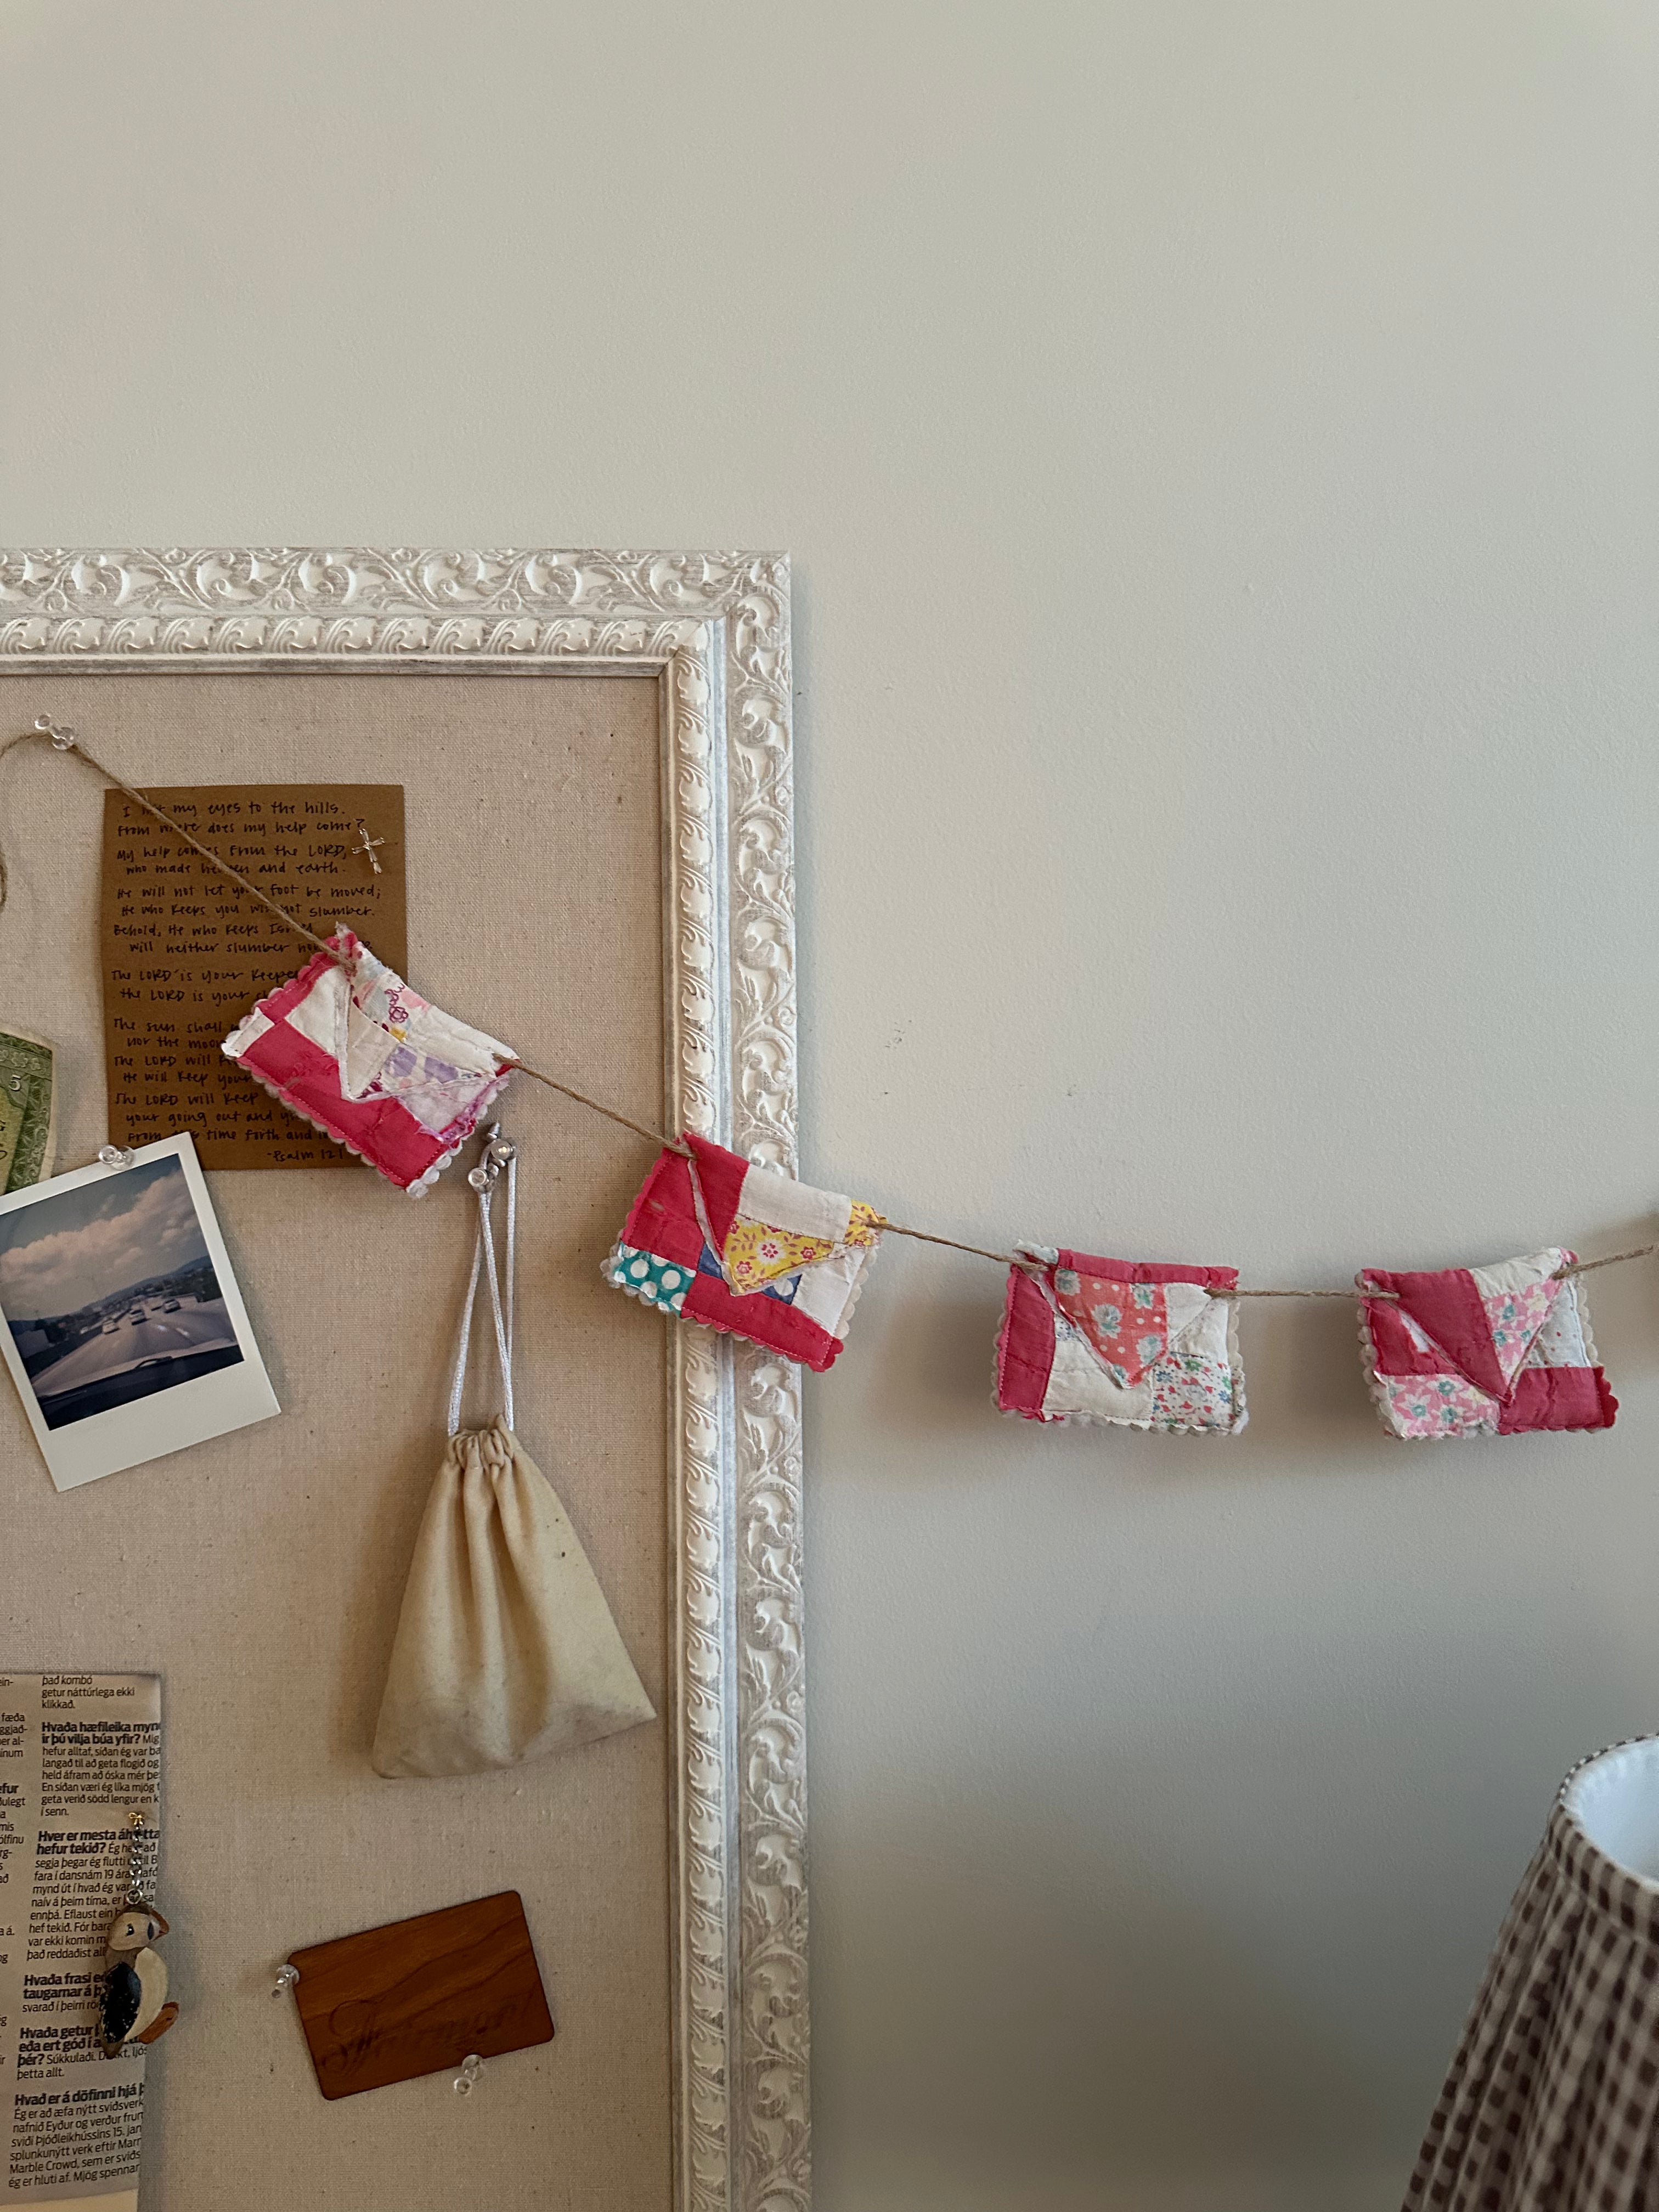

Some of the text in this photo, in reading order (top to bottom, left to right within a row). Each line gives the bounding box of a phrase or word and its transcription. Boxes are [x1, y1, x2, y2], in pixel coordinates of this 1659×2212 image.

[173, 804, 197, 817] my
[208, 803, 240, 816] eyes
[271, 802, 295, 814] the
[305, 802, 345, 814] hills.
[208, 819, 365, 837] does my help come?
[117, 844, 346, 862] My help the LORD,
[127, 862, 346, 875] who made and earth.
[117, 884, 380, 899] He will not let foot be moved;
[142, 904, 163, 914] who
[216, 905, 239, 919] you
[168, 924, 184, 935] He
[193, 925, 217, 936] who
[129, 941, 290, 953] will neither slumber
[111, 969, 244, 984] The LORD your
[120, 988, 140, 999] the
[151, 990, 185, 1002] LORD
[212, 991, 250, 1005] your
[114, 1018, 135, 1030] The
[147, 1022, 175, 1032] sun
[187, 1022, 222, 1034] shall
[127, 1036, 179, 1047] nor the
[114, 1056, 133, 1066] The
[145, 1055, 176, 1066] LORD
[185, 1054, 211, 1066] will
[145, 1071, 167, 1083] will
[115, 1092, 215, 1106] The LORD will
[126, 1113, 159, 1126] your
[168, 1111, 207, 1127] going
[216, 1111, 241, 1122] out
[247, 1110, 273, 1122] and
[207, 1128, 236, 1141] time
[286, 1130, 312, 1140] and
[321, 1149, 343, 1159] 121
[42, 1675, 92, 1686] það kombó
[42, 1687, 134, 1698] getur náttúrlega ekki
[42, 1700, 76, 1709] klikkað.
[2, 1713, 25, 1722] fæða
[42, 1722, 131, 1732] Hvaða hæfileika
[67, 1733, 159, 1746] vilja búa yfir? Mig
[42, 1746, 66, 1756] hefur
[67, 1746, 93, 1757] alltaf,
[95, 1746, 119, 1756] síðan
[42, 1758, 145, 1769] langað geta flogið
[42, 1770, 145, 1780] held áfram óska mér
[55, 1782, 155, 1793] síðan væri líka mjög
[41, 1794, 138, 1805] geta verið södd lengur
[38, 1829, 116, 1842] Hver mesta
[36, 1842, 106, 1855] hefur tekið?
[35, 1856, 125, 1870] segja þegar flutti
[34, 1870, 102, 1881] fara dansnám
[32, 1882, 131, 1896] mynd hvað var
[61, 1895, 83, 1908] þeim
[30, 1908, 113, 1921] ennþá. Eflaust ein
[29, 1922, 89, 1933] hef tekið. Fór
[28, 1936, 94, 1946] var ekki komin
[27, 1948, 91, 1961] það reddaðist
[24, 1972, 92, 1986] Hvaða frasi
[22, 2000, 85, 2012] svarað þeirri
[20, 2027, 58, 2039] Hvaða
[60, 2025, 93, 2039] getur
[19, 2036, 86, 2053] eða ert góð
[17, 2053, 45, 2068] þér?
[46, 2051, 97, 2065] Súkkulaði.
[17, 2066, 64, 2080] þetta allt.
[15, 2083, 137, 2106] Hvað döfinni hjá
[54, 2104, 97, 2118] æfa nýtt
[13, 2114, 121, 2134] nafnið Eyður verður
[11, 2136, 34, 2147] sviði
[10, 2140, 116, 2163] splunkunýtt verk eftir
[9, 2162, 44, 2175] Marble
[45, 2158, 80, 2171] Crowd,
[82, 2157, 103, 2168] sem
[33, 2170, 98, 2185] hluti Mjög
